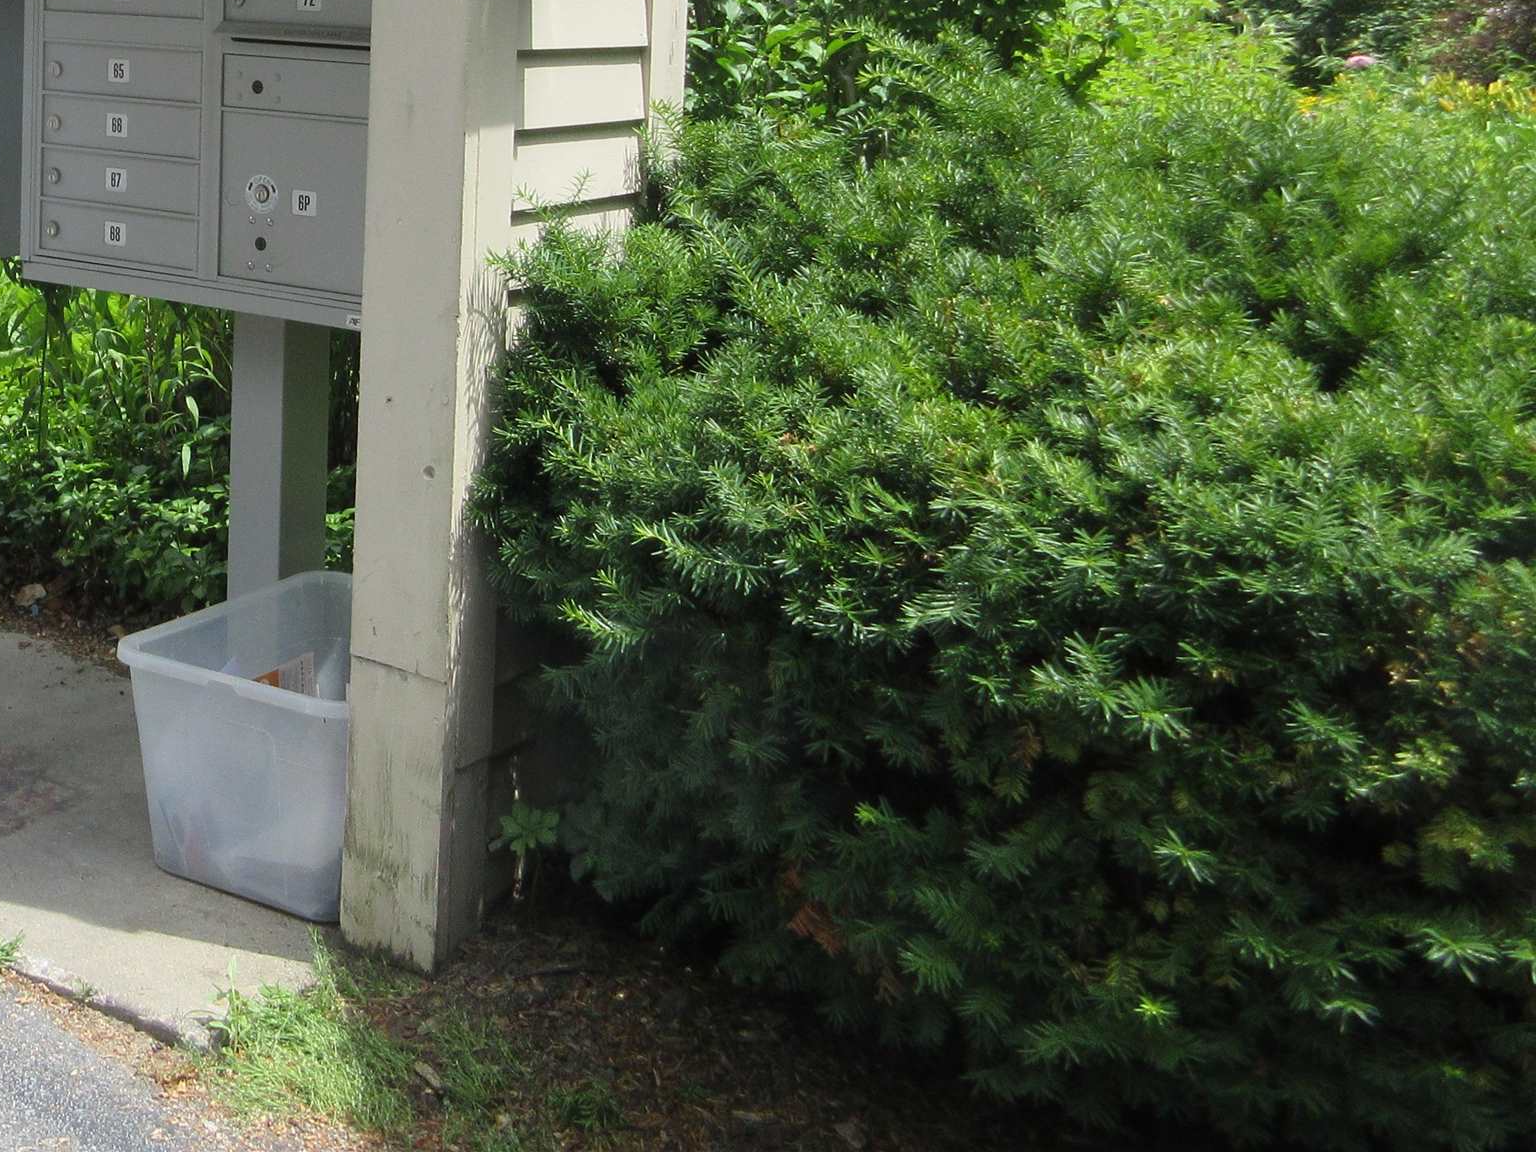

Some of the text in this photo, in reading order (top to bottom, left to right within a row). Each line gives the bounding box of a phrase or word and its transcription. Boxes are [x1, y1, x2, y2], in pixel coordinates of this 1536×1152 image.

[113, 62, 125, 79] 65
[111, 117, 123, 133] 66
[110, 171, 122, 188] 67
[298, 194, 311, 211] 6P
[109, 225, 121, 242] 68
